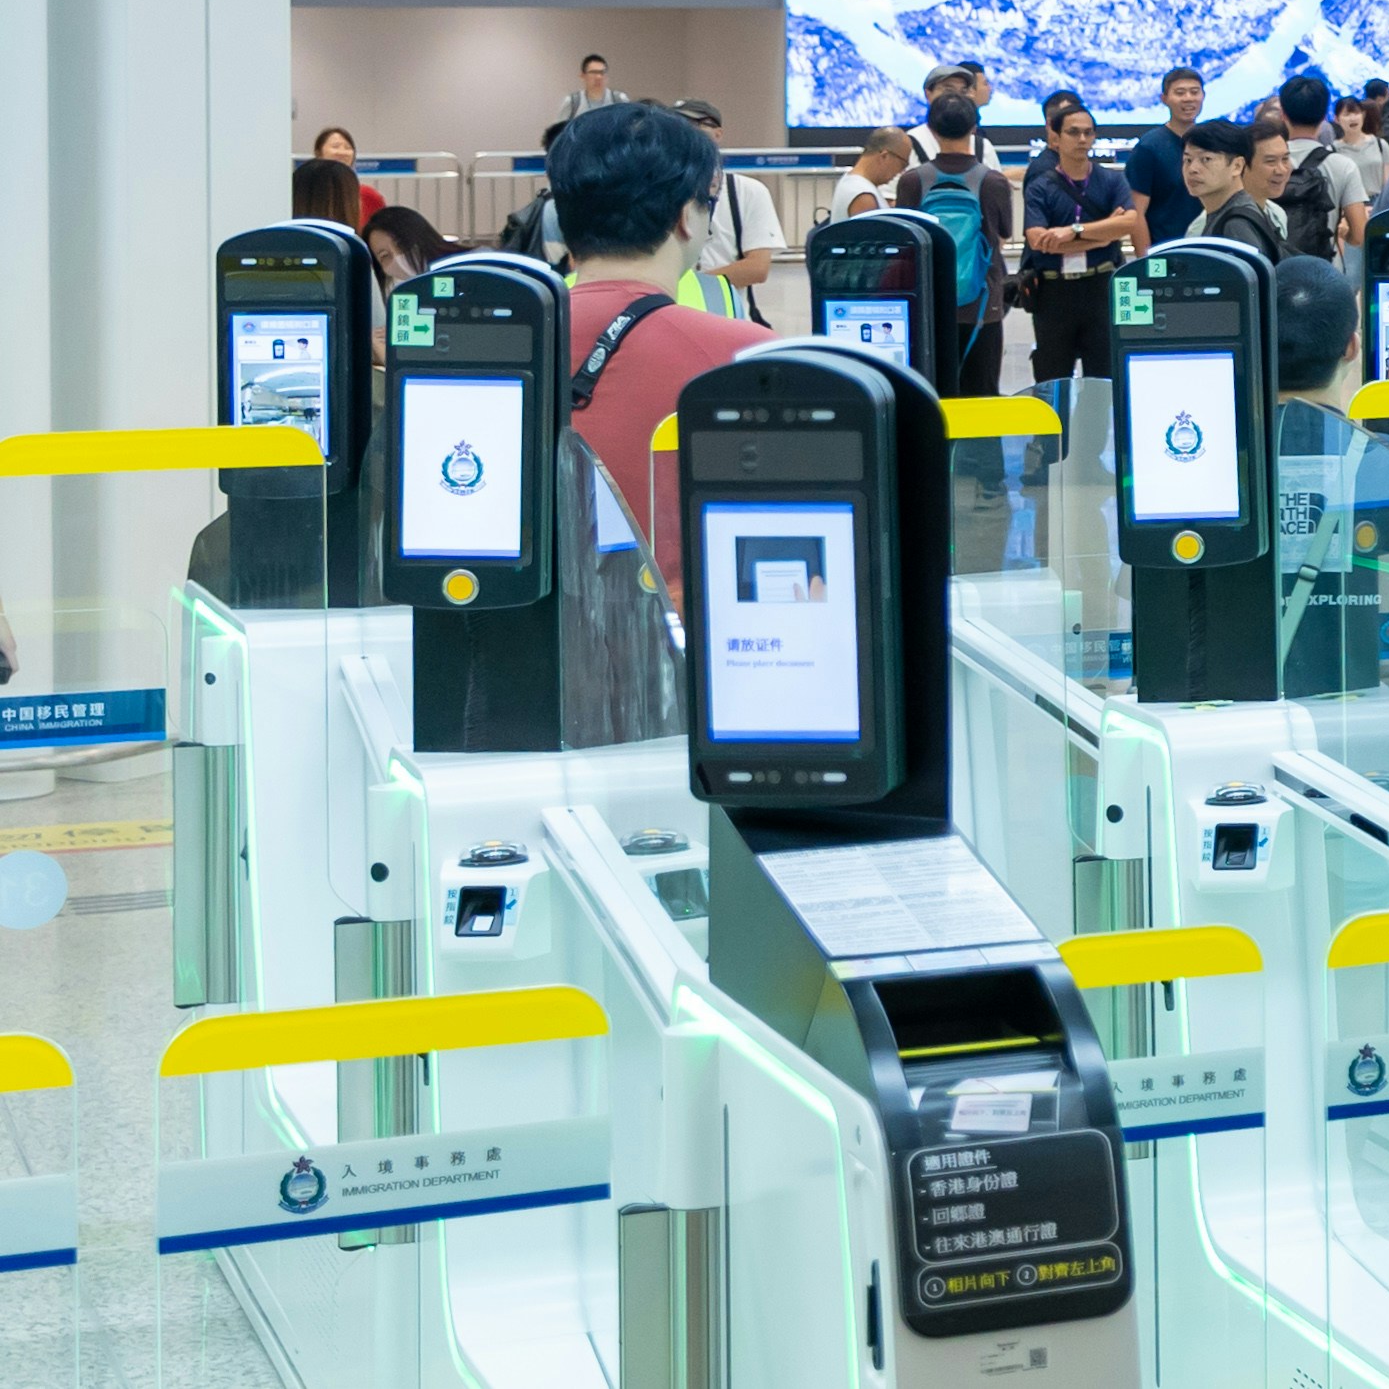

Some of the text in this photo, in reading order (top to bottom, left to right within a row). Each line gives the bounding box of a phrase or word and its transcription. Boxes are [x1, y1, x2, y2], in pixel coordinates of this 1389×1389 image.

[1280, 521, 1307, 534] ACE
[1310, 594, 1382, 606] XPLORING
[727, 638, 783, 652] 请放证件
[2, 703, 105, 722] 中国移民管理
[4, 719, 102, 732] CHINA IMMIGRATION
[1178, 1089, 1246, 1104] DEPARTMENT
[341, 1147, 502, 1179] 入境事務處
[342, 1170, 501, 1197] IMMIGRATION DEPARTMENT
[930, 1171, 1018, 1198] 香港身份證
[947, 1270, 1011, 1294] 相片向下
